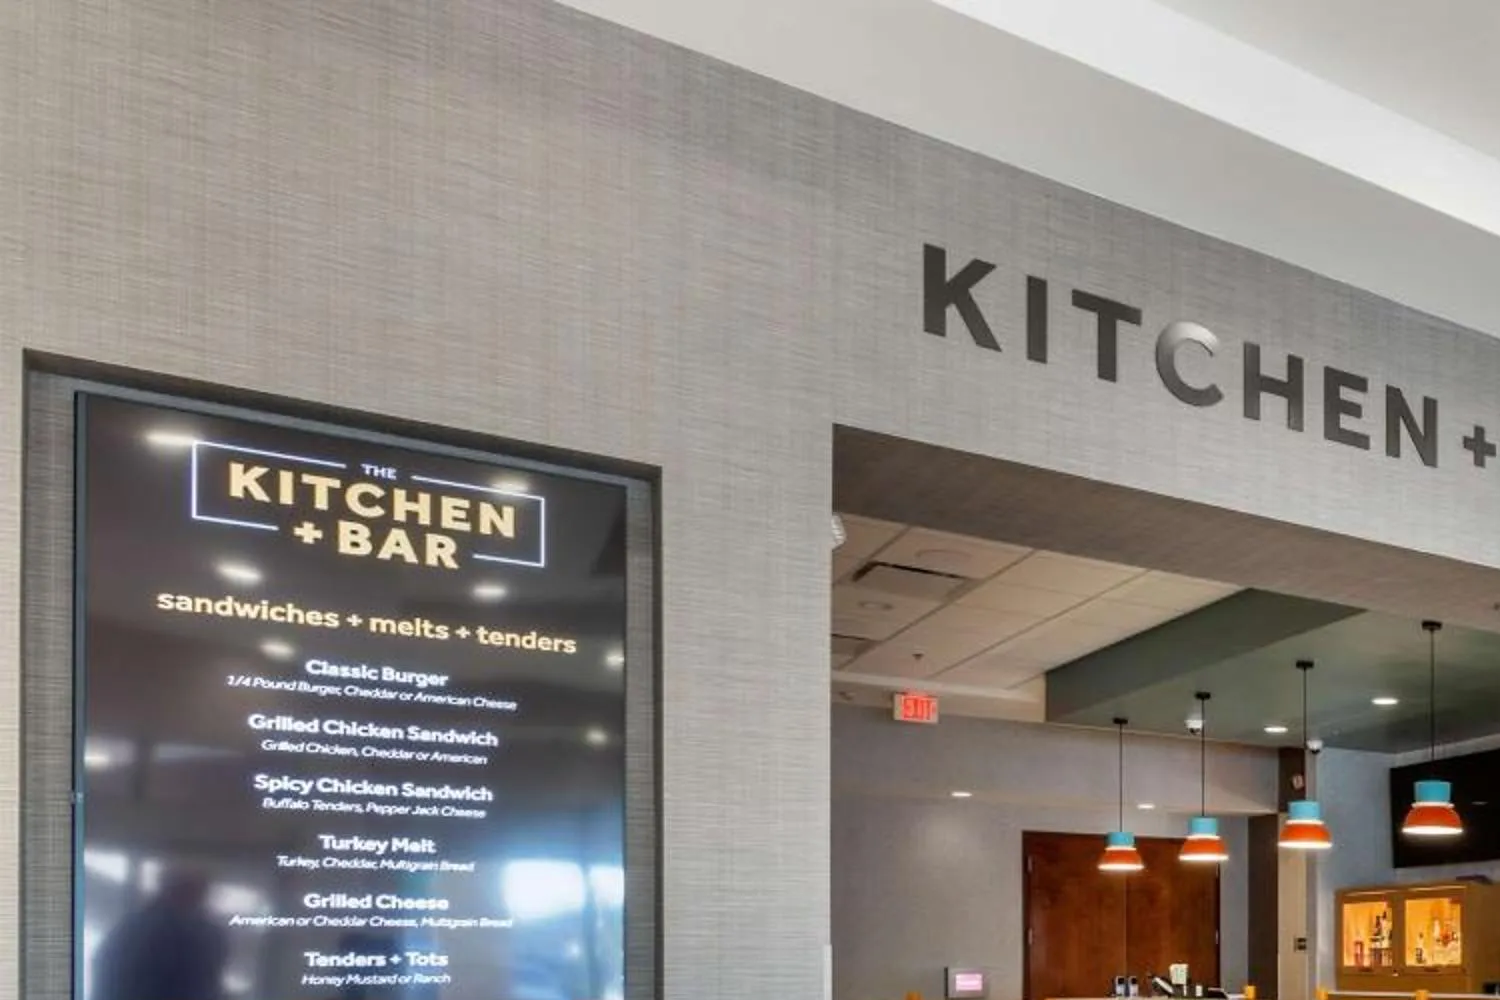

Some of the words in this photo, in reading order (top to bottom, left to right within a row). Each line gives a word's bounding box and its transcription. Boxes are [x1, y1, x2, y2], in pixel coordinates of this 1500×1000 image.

[361, 463, 397, 480] THE
[229, 461, 516, 538] KITCHEN
[338, 519, 459, 569] BAR
[157, 592, 340, 628] sandwiches
[369, 615, 449, 640] melts
[475, 625, 577, 654] tenders
[305, 659, 379, 680] Classic
[381, 665, 449, 688] Burger
[253, 676, 297, 691] Pound
[343, 685, 398, 700] Cheddar
[399, 691, 414, 701] or
[414, 691, 471, 706] American
[473, 696, 518, 710] Cheese
[248, 713, 319, 733] Grilled
[322, 719, 404, 739] Chicken
[407, 725, 499, 747] Sandwich
[261, 739, 305, 753] Grilled
[361, 745, 415, 760] Cheddar
[430, 751, 489, 765] American
[253, 774, 314, 795] Spicy
[316, 777, 398, 796] Chicken
[401, 782, 494, 802] Sandwich
[262, 797, 310, 810] Buffalo
[441, 806, 487, 819] Cheese
[317, 834, 390, 855] Turkey
[391, 837, 438, 853] Melt
[303, 893, 373, 909] Grilled
[375, 894, 450, 910] Cheese
[228, 914, 295, 927] American
[296, 917, 312, 927] or
[313, 915, 369, 927] Cheddar
[304, 951, 387, 967] Tenders
[404, 951, 449, 967] Tots
[301, 973, 347, 987] Honey
[346, 973, 399, 986] Mustard
[398, 975, 413, 985] or
[413, 972, 452, 985] Ranch
